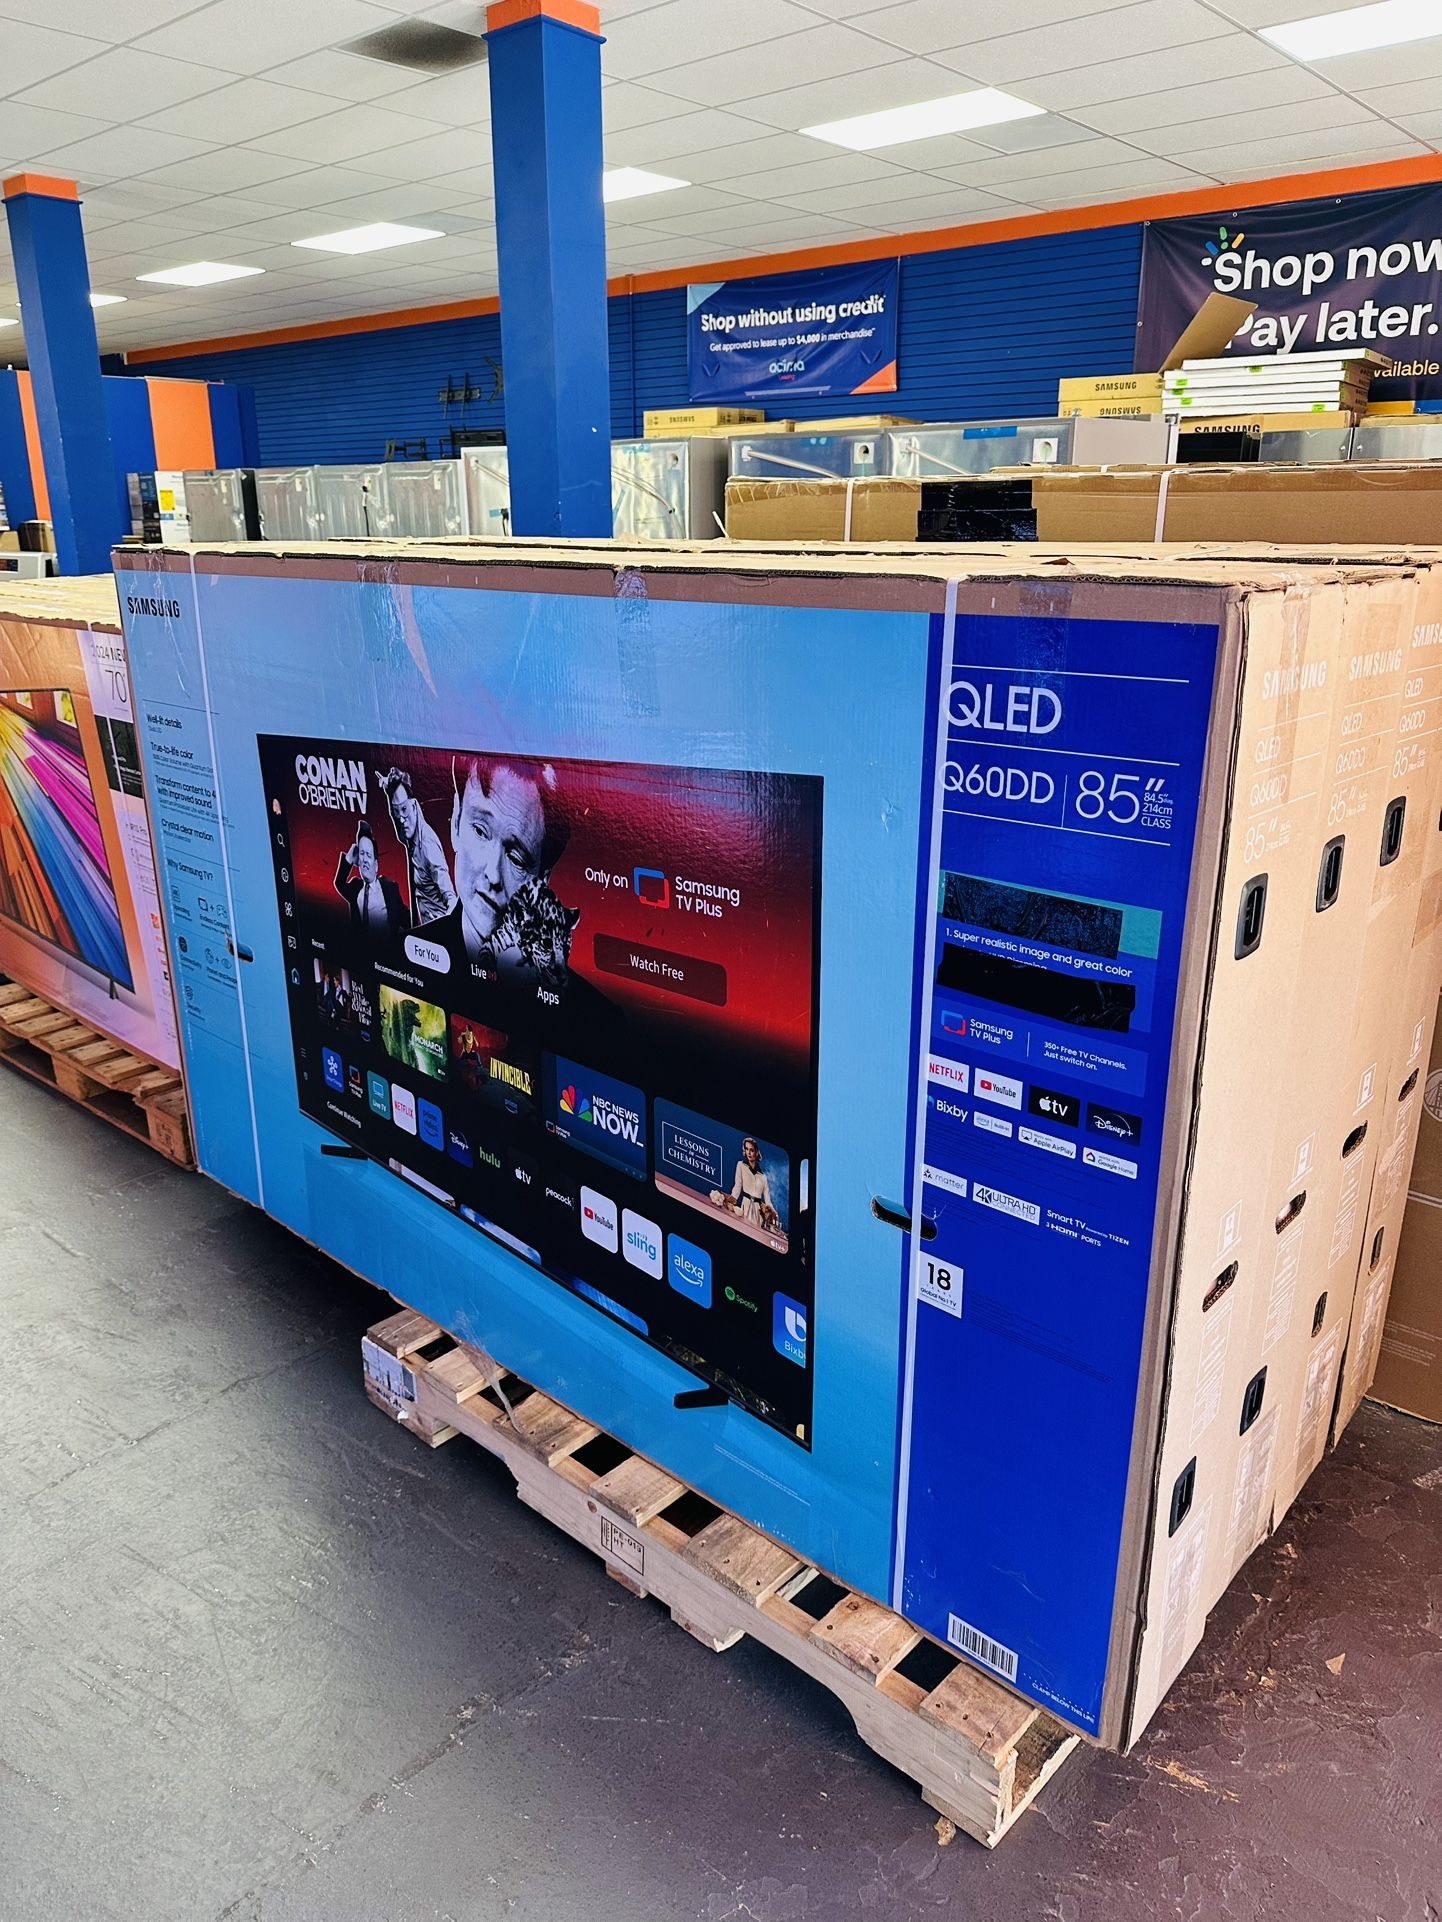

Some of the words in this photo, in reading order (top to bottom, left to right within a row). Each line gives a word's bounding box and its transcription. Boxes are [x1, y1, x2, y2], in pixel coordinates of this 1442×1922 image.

[1213, 248, 1334, 295] Shop
[701, 313, 736, 333] Shop
[738, 307, 792, 327] without
[795, 302, 836, 324] using
[1315, 300, 1439, 343] later.
[709, 342, 722, 352] Get
[721, 339, 752, 353] approved
[752, 340, 760, 349] to
[760, 338, 777, 348] lease
[777, 338, 787, 349] up
[788, 336, 796, 346] to
[796, 333, 820, 346] $4,000
[820, 333, 828, 342] in
[769, 358, 805, 374] acima
[1095, 381, 1137, 392] SAMSUNG
[1100, 406, 1142, 416] SAMSUNG
[127, 596, 180, 618] SAMSUNG
[1349, 649, 1403, 682] SAMSUNG
[1262, 660, 1327, 700] SAMSUNG
[1405, 678, 1424, 698] QLED
[942, 680, 1062, 735] QLED
[164, 717, 182, 729] details
[1341, 712, 1362, 736] QLED
[150, 742, 179, 757] True-to-life
[180, 750, 193, 760] color
[1255, 736, 1282, 764] QLED
[295, 754, 366, 792] CONAN
[938, 761, 1055, 804] Q60DD
[155, 775, 182, 789] Transform
[183, 783, 204, 796] content
[204, 788, 211, 797] to
[157, 786, 168, 797] with
[169, 789, 194, 804] improved
[194, 797, 212, 809] sound
[1142, 802, 1173, 815] 214cm
[162, 818, 180, 831] Crystal
[180, 825, 193, 835] clear
[194, 830, 214, 842] motion
[1141, 816, 1171, 829] CLASS
[179, 862, 203, 880] Samsung
[203, 871, 214, 881] TV?
[585, 867, 610, 888] Only
[613, 875, 628, 888] on
[675, 876, 740, 907] Samsung
[675, 894, 693, 911] TV
[695, 898, 723, 918] Plus
[414, 944, 425, 957] For
[425, 948, 440, 963] You
[945, 927, 952, 937] 1.
[953, 929, 980, 943] Super
[981, 936, 1017, 952] realistic
[1019, 943, 1050, 960] image
[1051, 951, 1072, 965] and
[1073, 957, 1103, 972] great
[1104, 964, 1133, 978] color
[374, 962, 407, 981] Recommended
[406, 973, 414, 983] for
[414, 976, 424, 987] You
[471, 963, 487, 979] Live
[630, 954, 660, 975] Watch
[662, 965, 684, 981] Free
[537, 986, 559, 1005] Apps
[970, 1018, 1013, 1040] Samsung
[970, 1028, 982, 1039] TV
[983, 1031, 1001, 1045] Plus
[414, 1034, 443, 1054] MONARCH
[1043, 1049, 1059, 1061] Just
[1059, 1054, 1084, 1067] switch
[1085, 1062, 1098, 1071] on.
[1044, 1040, 1060, 1051] 350+
[1060, 1045, 1077, 1056] Free
[1079, 1050, 1089, 1060] TV
[1089, 1053, 1127, 1071] Channels.
[490, 1057, 532, 1096] INVINCIBLE
[929, 1062, 964, 1083] NETFLIX
[992, 1083, 1017, 1099] YouTube
[394, 1100, 414, 1119] NETFLIX
[592, 1095, 611, 1112] NBC
[612, 1104, 640, 1124] NEWS
[936, 1099, 969, 1123] Bixby
[1052, 1098, 1068, 1117] tv
[674, 1134, 710, 1157] LESSONS
[1033, 1137, 1051, 1149] Apple
[1052, 1143, 1074, 1156] AirPlay
[479, 1146, 500, 1168] hulu
[668, 1147, 716, 1176] CHEMISTRY
[1097, 1159, 1117, 1170] Google
[1118, 1165, 1134, 1175] Home
[522, 1168, 532, 1185] tv
[935, 1174, 964, 1189] matter
[545, 1187, 572, 1207] peacock
[976, 1188, 992, 1204] 4K
[992, 1192, 1020, 1209] ULTRA
[1022, 1204, 1036, 1215] HD
[594, 1210, 614, 1231] YouTube
[992, 1201, 1036, 1221] CONNECTED
[1047, 1209, 1073, 1225] Smart
[1075, 1219, 1086, 1229] TV
[1108, 1234, 1129, 1245] TIZEN
[627, 1231, 657, 1261] sling
[1081, 1234, 1101, 1247] PORTS
[674, 1252, 704, 1280] alexa
[927, 1262, 951, 1291] 18
[735, 1293, 758, 1313] Spotify
[1032, 1682, 1051, 1697] CLAMP
[1051, 1694, 1071, 1710] BELOW
[1070, 1705, 1083, 1717] THIS
[1082, 1713, 1095, 1724] LINE
